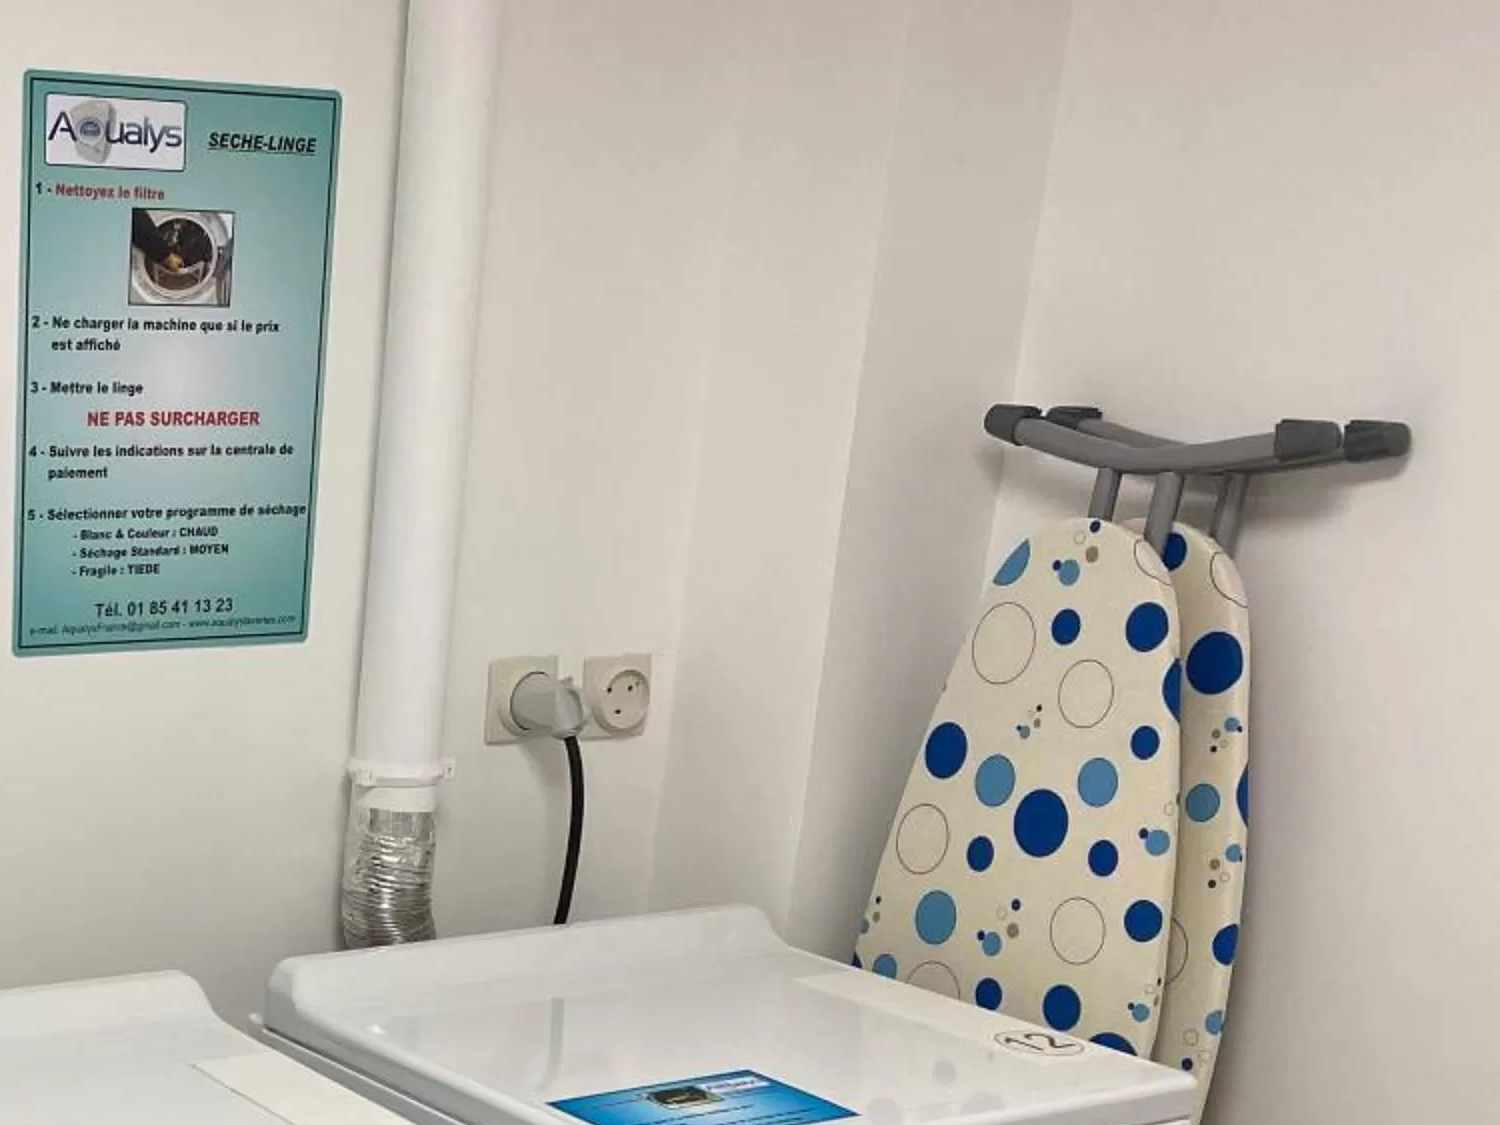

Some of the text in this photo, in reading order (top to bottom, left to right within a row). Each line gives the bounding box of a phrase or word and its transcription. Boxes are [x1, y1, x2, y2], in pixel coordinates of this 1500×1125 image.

[208, 132, 316, 152] SECHE-LINGE
[56, 184, 164, 200] Nettoyez filtre
[52, 318, 279, 335] Ne charger machine que prix
[52, 338, 120, 350] est affiché
[51, 382, 143, 396] Mettre linge
[88, 411, 260, 426] NE PAS SURCHARGER
[49, 444, 293, 457] Suivre les indications sur centrale de
[48, 467, 108, 481] paiement
[48, 504, 306, 521] Sélectionner votre programme de séchage
[80, 526, 218, 540] Blanc Couleur CHAUD
[80, 544, 229, 561] Séchage Standard MOYEN
[79, 564, 160, 578] Fragile TIEDE
[95, 598, 233, 618] Tél. 01 85 41 13 23
[1005, 1033, 1077, 1050] 12
